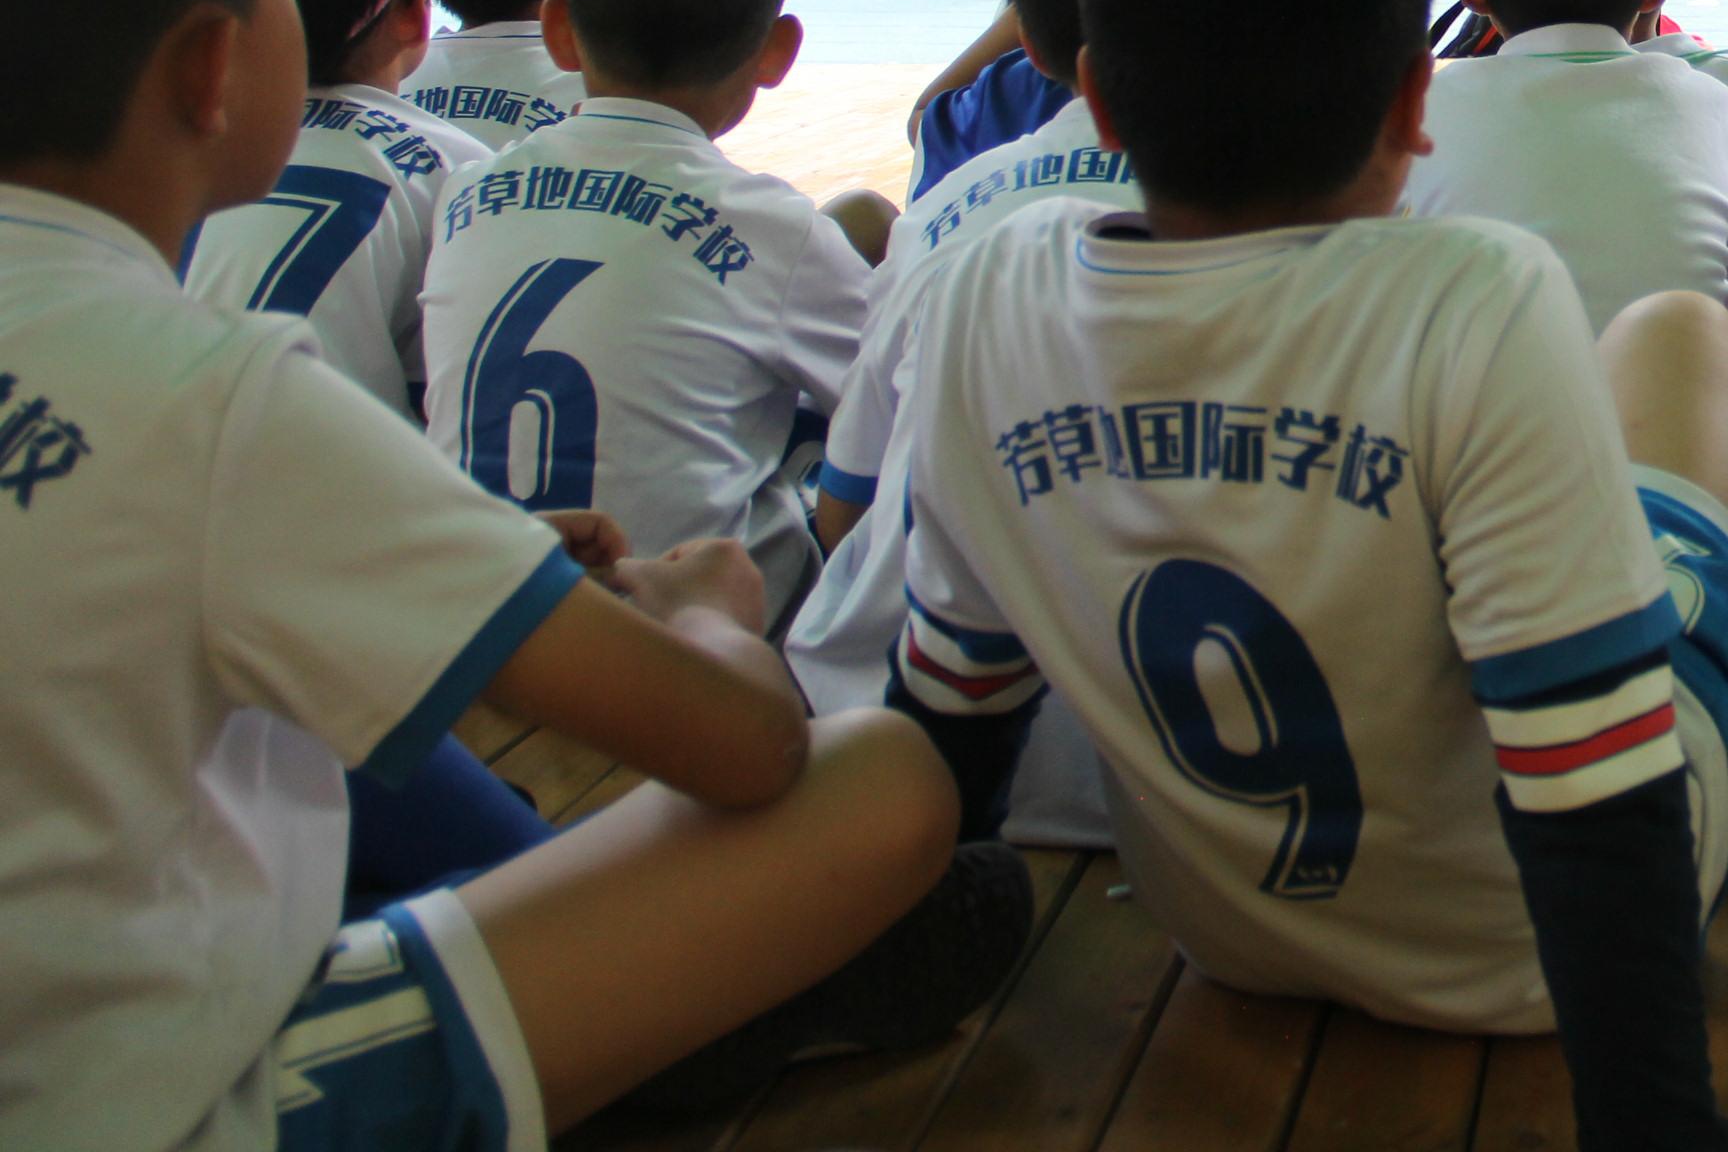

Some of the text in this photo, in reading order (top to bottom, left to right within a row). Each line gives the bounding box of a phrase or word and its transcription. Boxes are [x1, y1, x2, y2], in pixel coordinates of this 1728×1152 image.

[300, 98, 442, 183] 际学校
[400, 85, 568, 132] 地国际学
[228, 165, 392, 318] 7
[445, 166, 754, 286] 芳草地国际学校
[0, 372, 93, 512] 校
[459, 257, 606, 512] 6
[1118, 559, 1365, 901] 9
